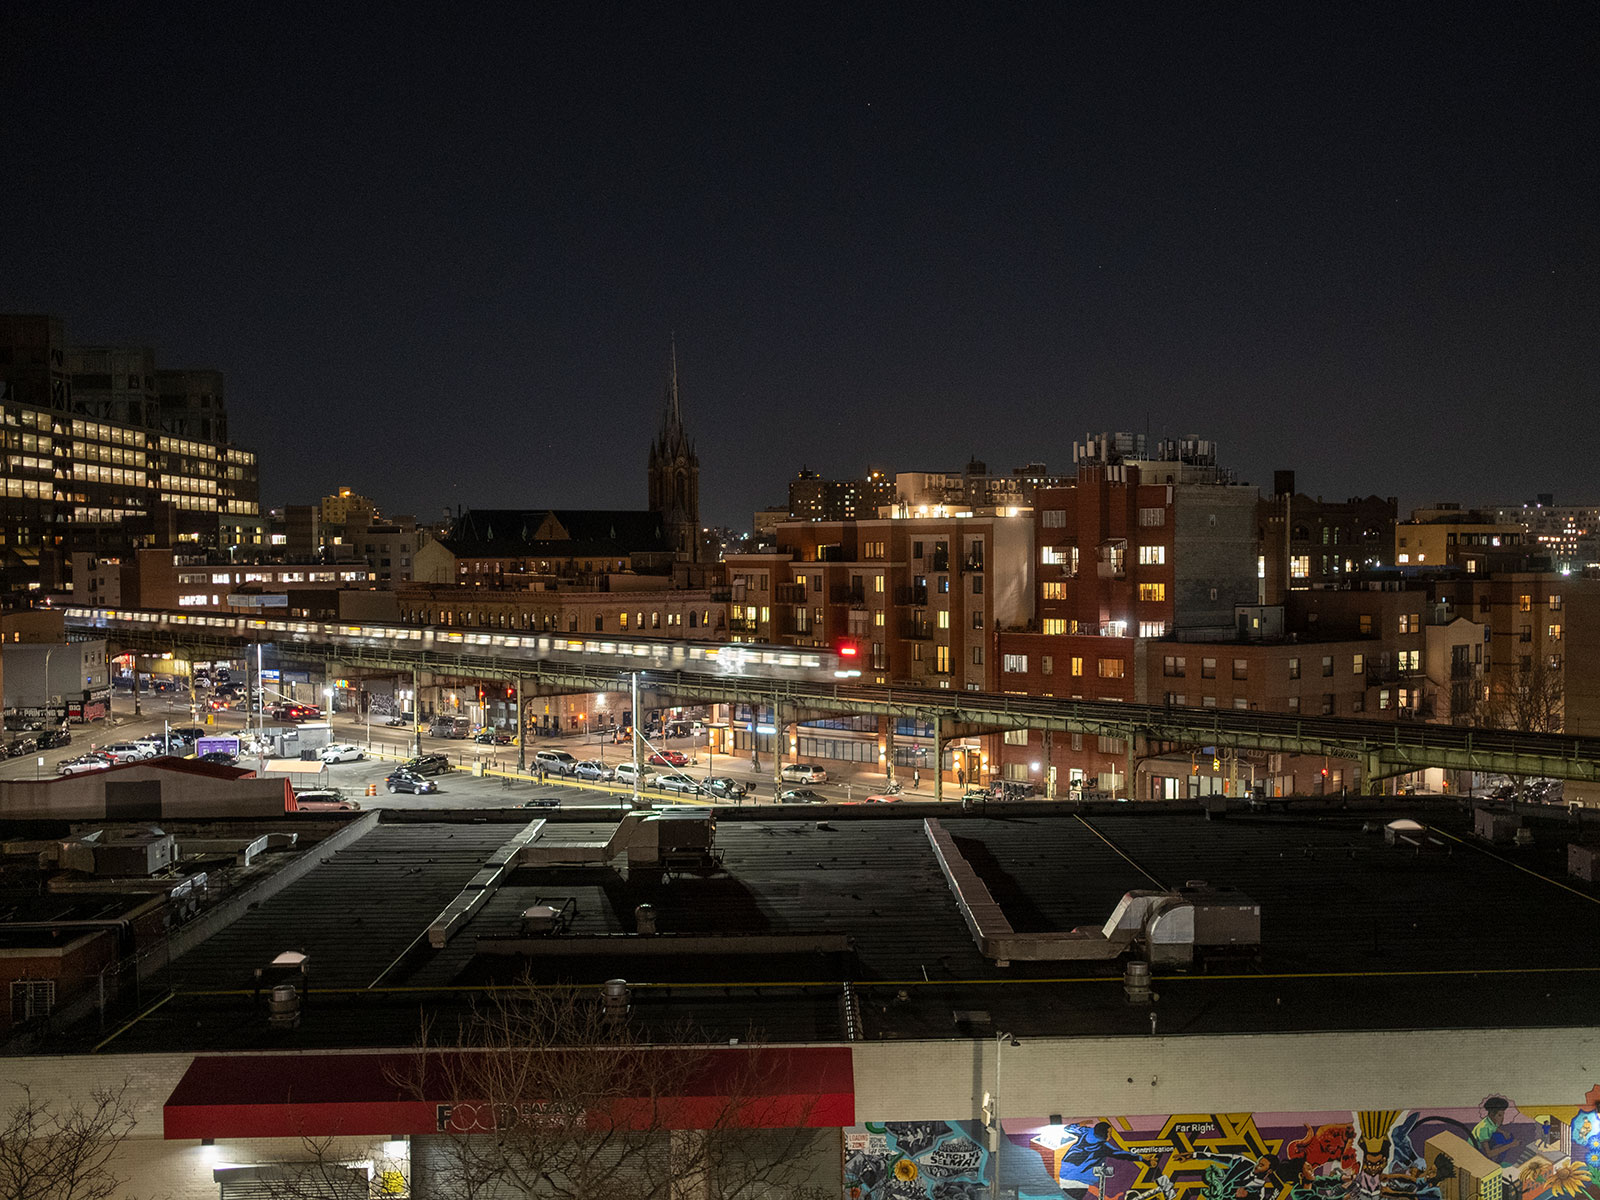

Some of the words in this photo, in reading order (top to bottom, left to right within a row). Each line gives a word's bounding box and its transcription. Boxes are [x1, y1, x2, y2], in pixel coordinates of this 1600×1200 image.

[436, 1102, 519, 1132] FOOD
[1175, 1124, 1190, 1132] Far
[1191, 1122, 1215, 1134] Right
[849, 1134, 869, 1142] LOADING
[932, 1150, 966, 1160] MARCH
[1130, 1146, 1174, 1154] Gentrification
[930, 1156, 980, 1167] SELMA!
